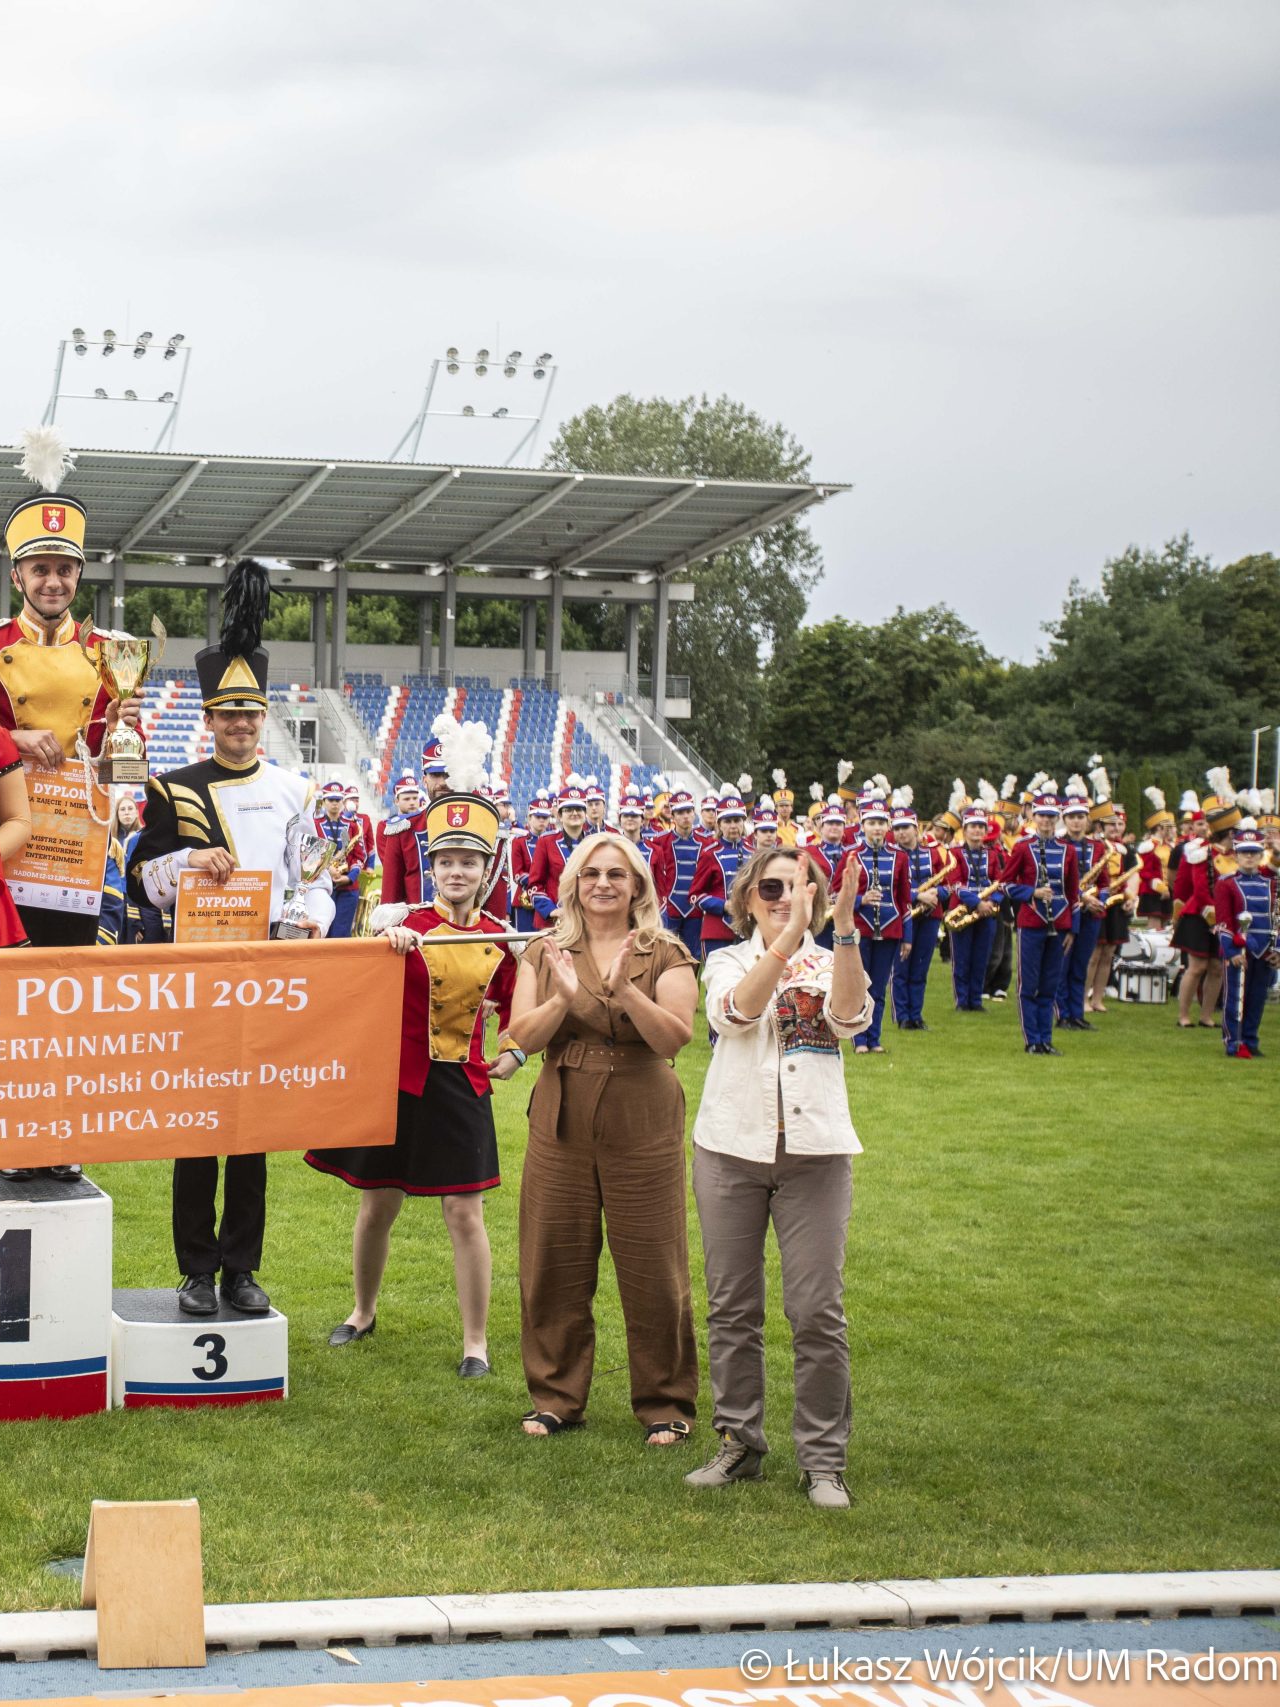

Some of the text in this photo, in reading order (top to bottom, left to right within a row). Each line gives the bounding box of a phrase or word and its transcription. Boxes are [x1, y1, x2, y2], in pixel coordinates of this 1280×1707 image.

[114, 596, 125, 608] K
[446, 608, 456, 620] L
[54, 808, 67, 816] DLA
[31, 834, 83, 847] MISTRZ POLSKI
[35, 843, 83, 856] KONKURENCJI
[25, 851, 84, 865] ENTERTAINMENT
[13, 869, 39, 879] RADOM
[196, 896, 252, 908] DYPLOM
[16, 972, 196, 1016] POLSKI
[211, 978, 309, 1011] 2025
[66, 1071, 142, 1096] Polski
[150, 1067, 252, 1091] Orkiestr
[259, 1059, 347, 1090] Dętych
[15, 1119, 72, 1139] 12-13
[81, 1109, 159, 1134] LIPCA
[165, 1110, 219, 1130] 2025
[191, 1333, 228, 1381] 3
